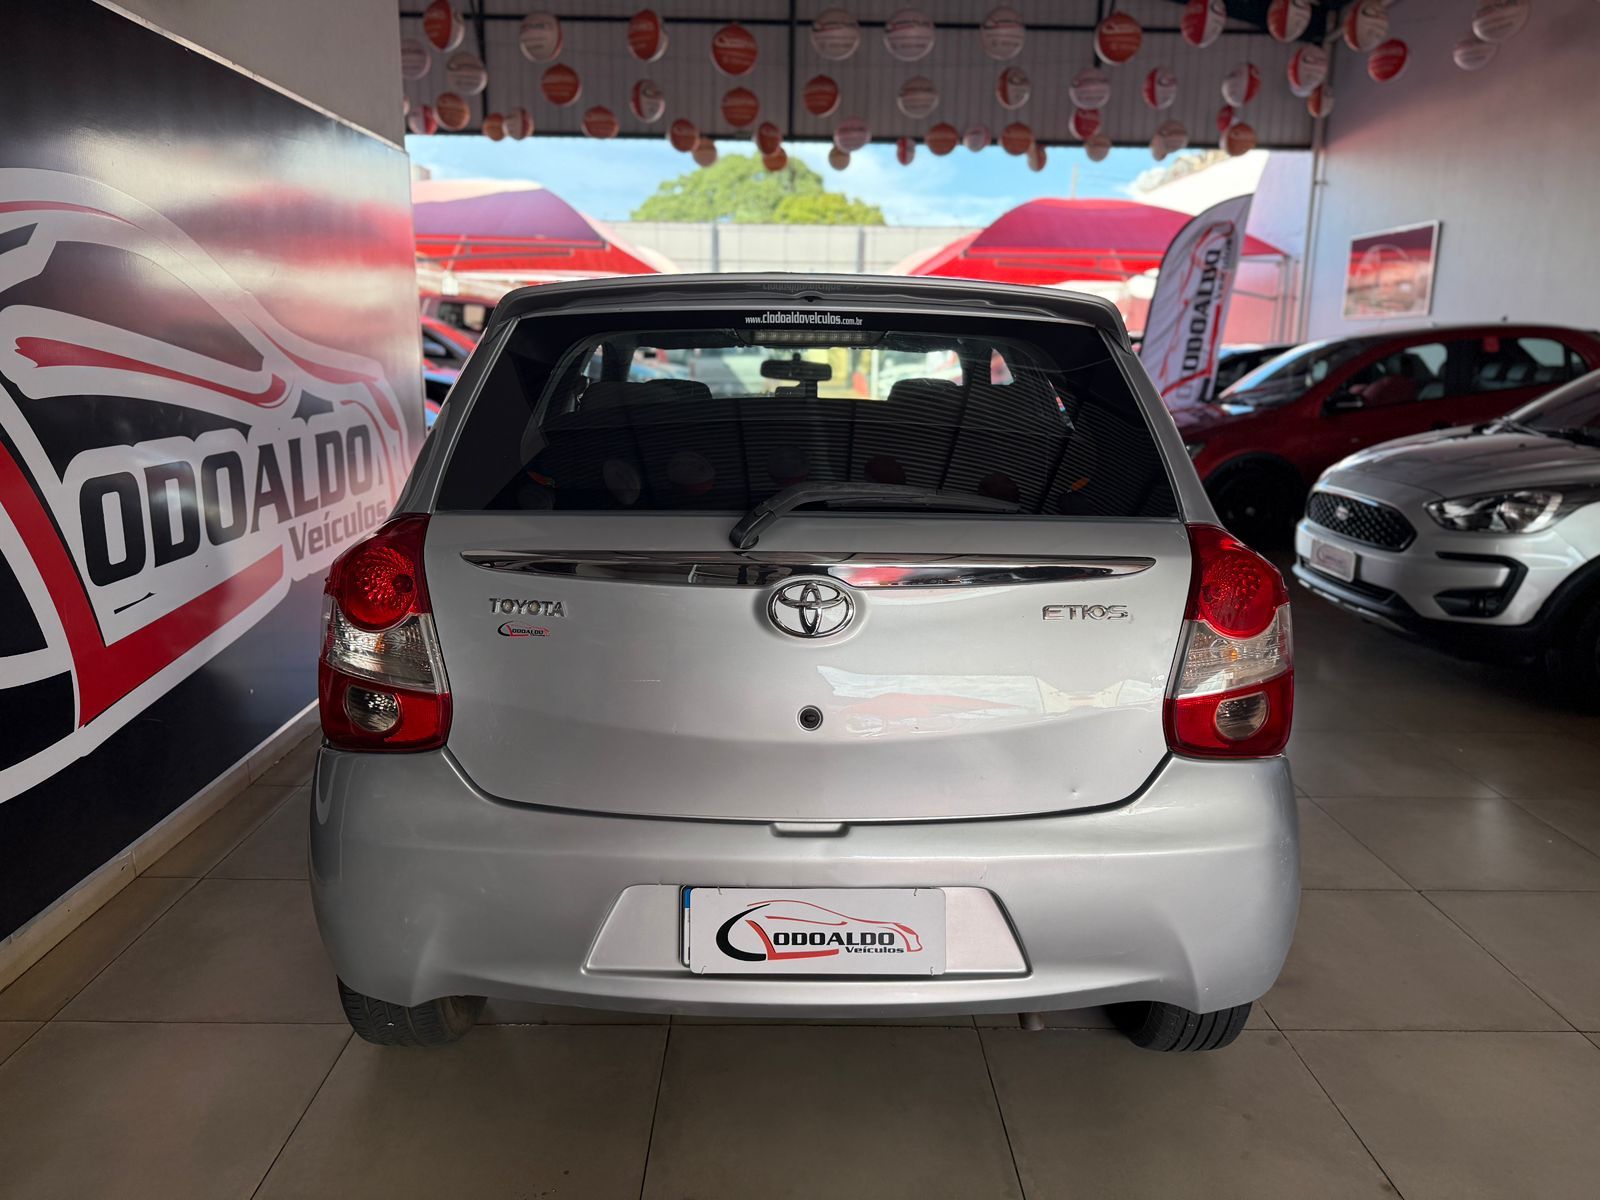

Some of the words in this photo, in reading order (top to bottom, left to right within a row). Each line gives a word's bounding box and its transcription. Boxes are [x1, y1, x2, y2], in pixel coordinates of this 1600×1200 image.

[288, 499, 388, 561] Veículos
[489, 598, 566, 618] TOYOTA
[1042, 604, 1128, 620] ETIOS
[845, 945, 905, 955] Veículos
